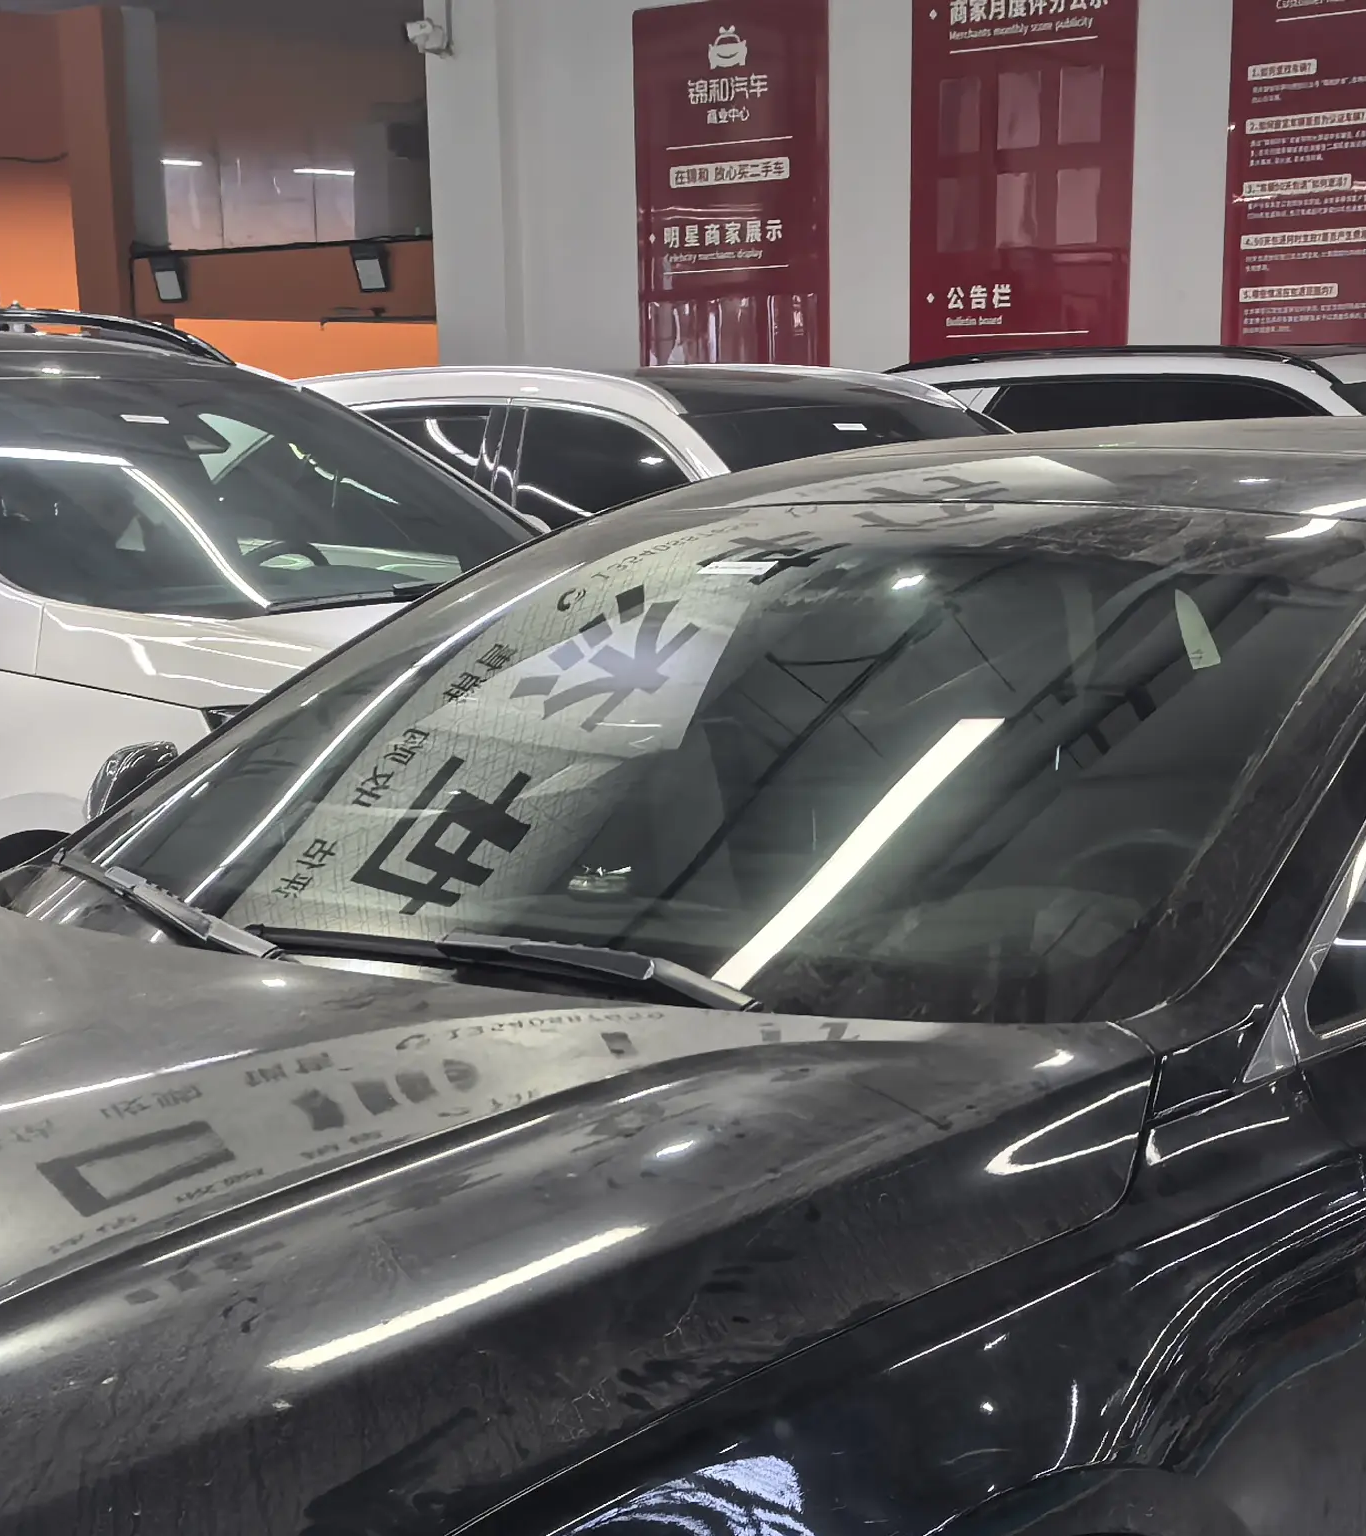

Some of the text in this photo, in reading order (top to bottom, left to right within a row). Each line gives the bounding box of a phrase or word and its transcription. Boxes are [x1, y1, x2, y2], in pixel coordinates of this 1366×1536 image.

[688, 73, 769, 105] 锦和汽车
[707, 106, 750, 124] 商业中心
[714, 161, 785, 182] 放心买二手车
[663, 219, 783, 249] 明星商家展示
[947, 283, 1012, 310] 公告栏
